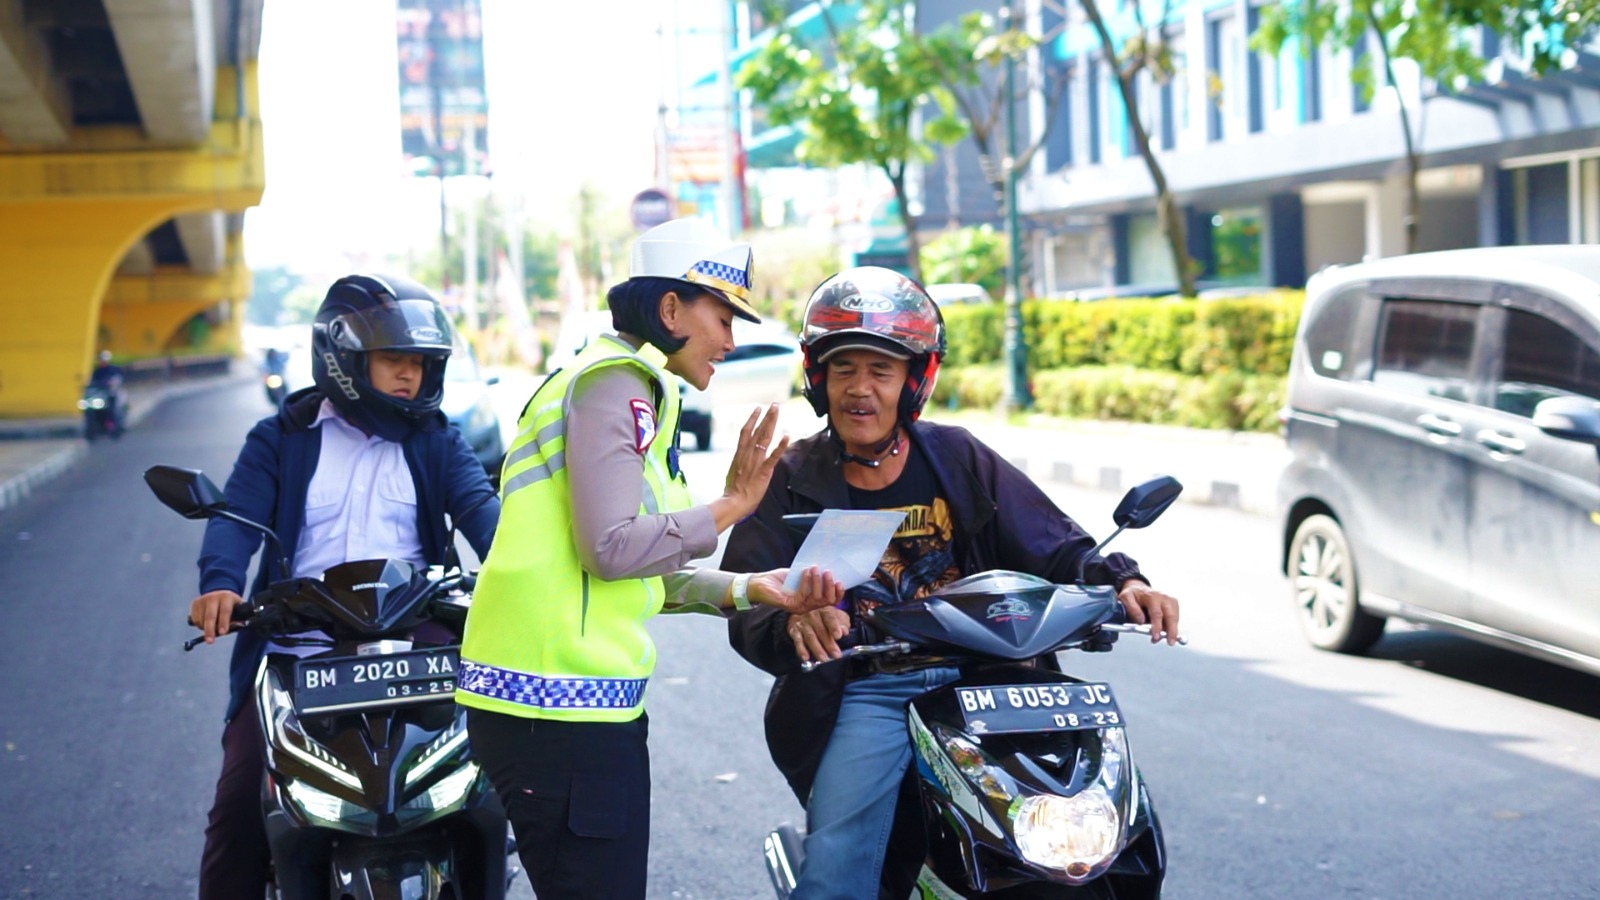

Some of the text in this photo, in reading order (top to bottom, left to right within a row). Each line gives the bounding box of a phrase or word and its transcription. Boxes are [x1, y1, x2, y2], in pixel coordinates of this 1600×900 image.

[305, 655, 453, 689] BM 2020 XA
[961, 684, 1111, 712] BM 6053 JC
